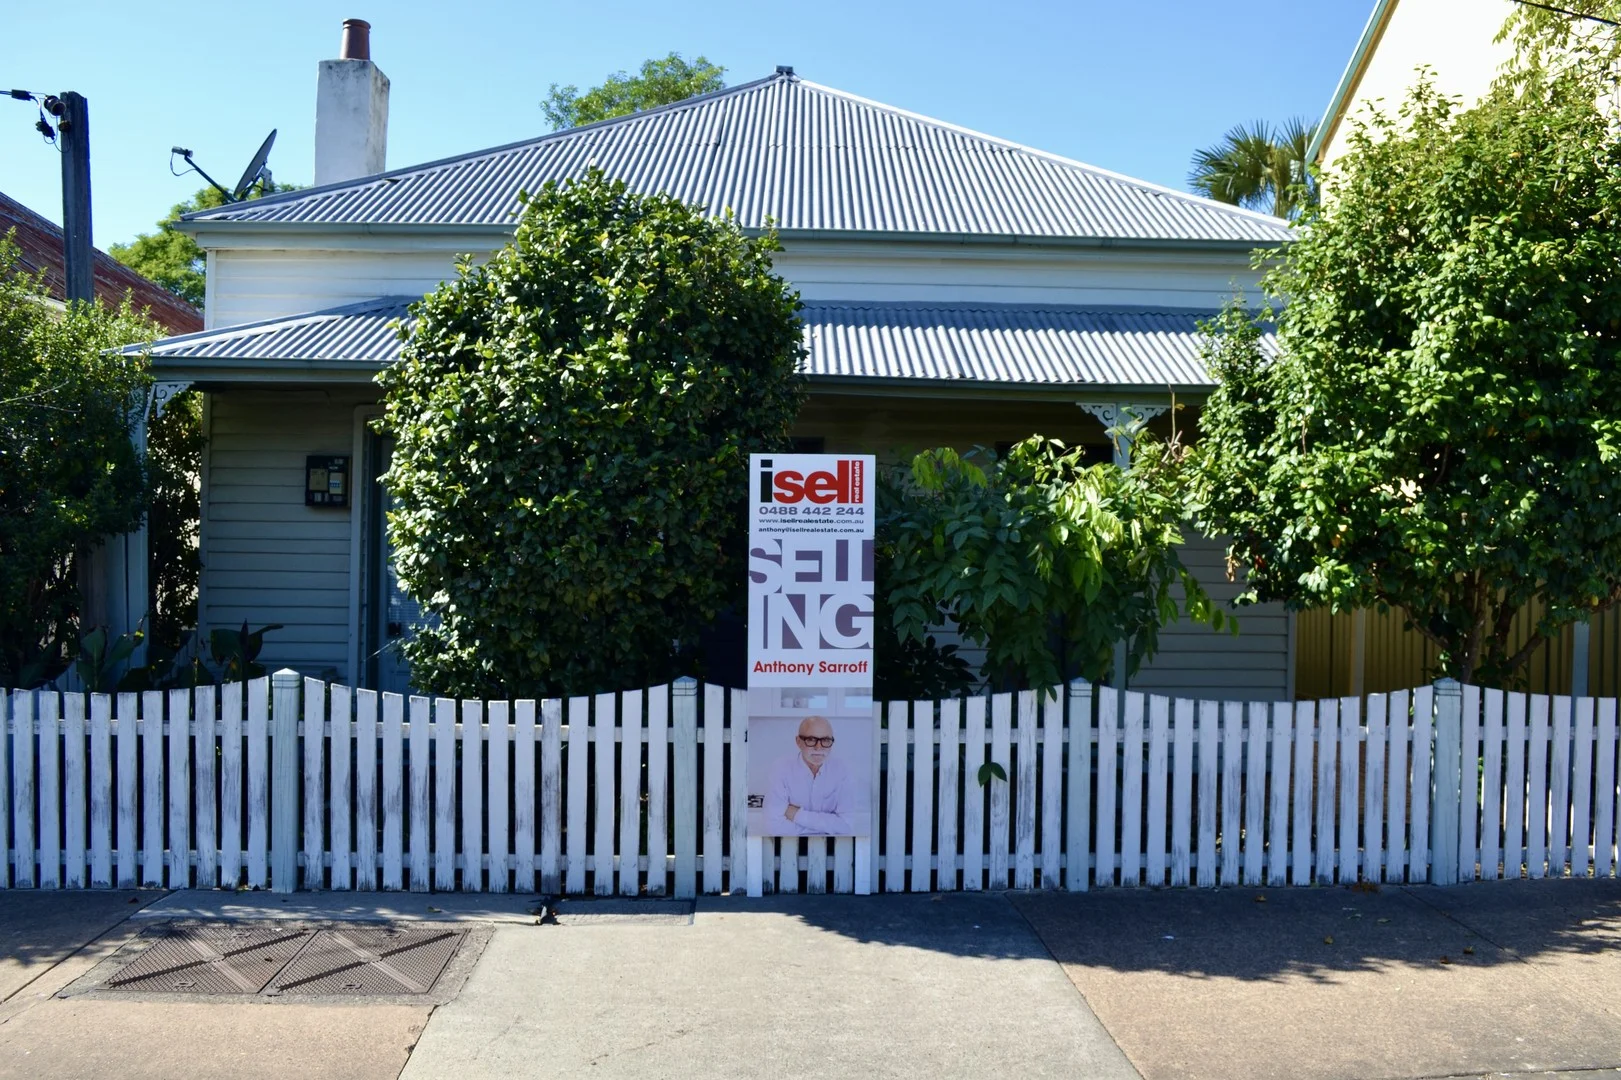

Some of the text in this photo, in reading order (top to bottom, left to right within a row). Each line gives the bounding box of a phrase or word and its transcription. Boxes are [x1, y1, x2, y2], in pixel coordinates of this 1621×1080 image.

[760, 459, 864, 504] isell
[759, 506, 865, 516] 0488 442 244
[753, 660, 868, 676] Anthony Sarroff
